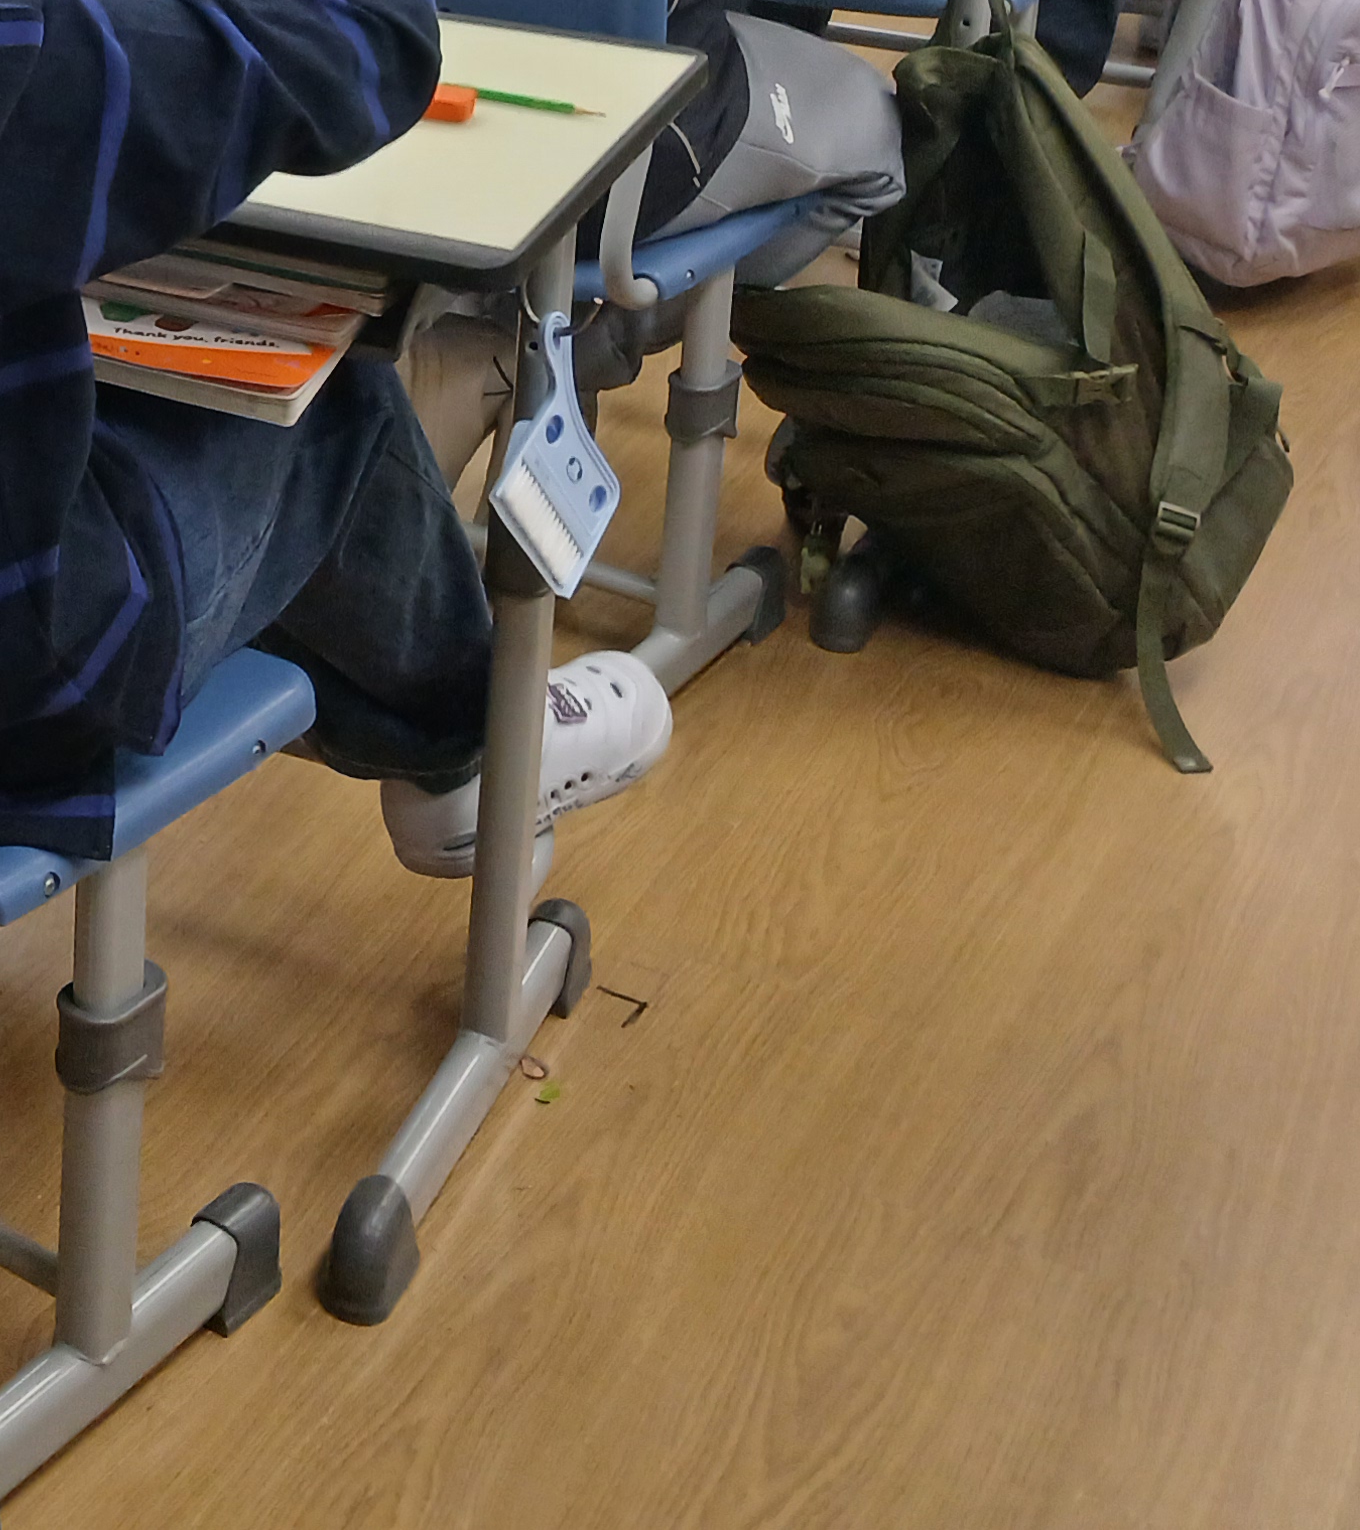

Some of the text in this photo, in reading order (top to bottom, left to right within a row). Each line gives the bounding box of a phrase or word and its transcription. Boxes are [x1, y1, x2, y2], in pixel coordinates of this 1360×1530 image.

[113, 327, 280, 349] Thank you, friends.
